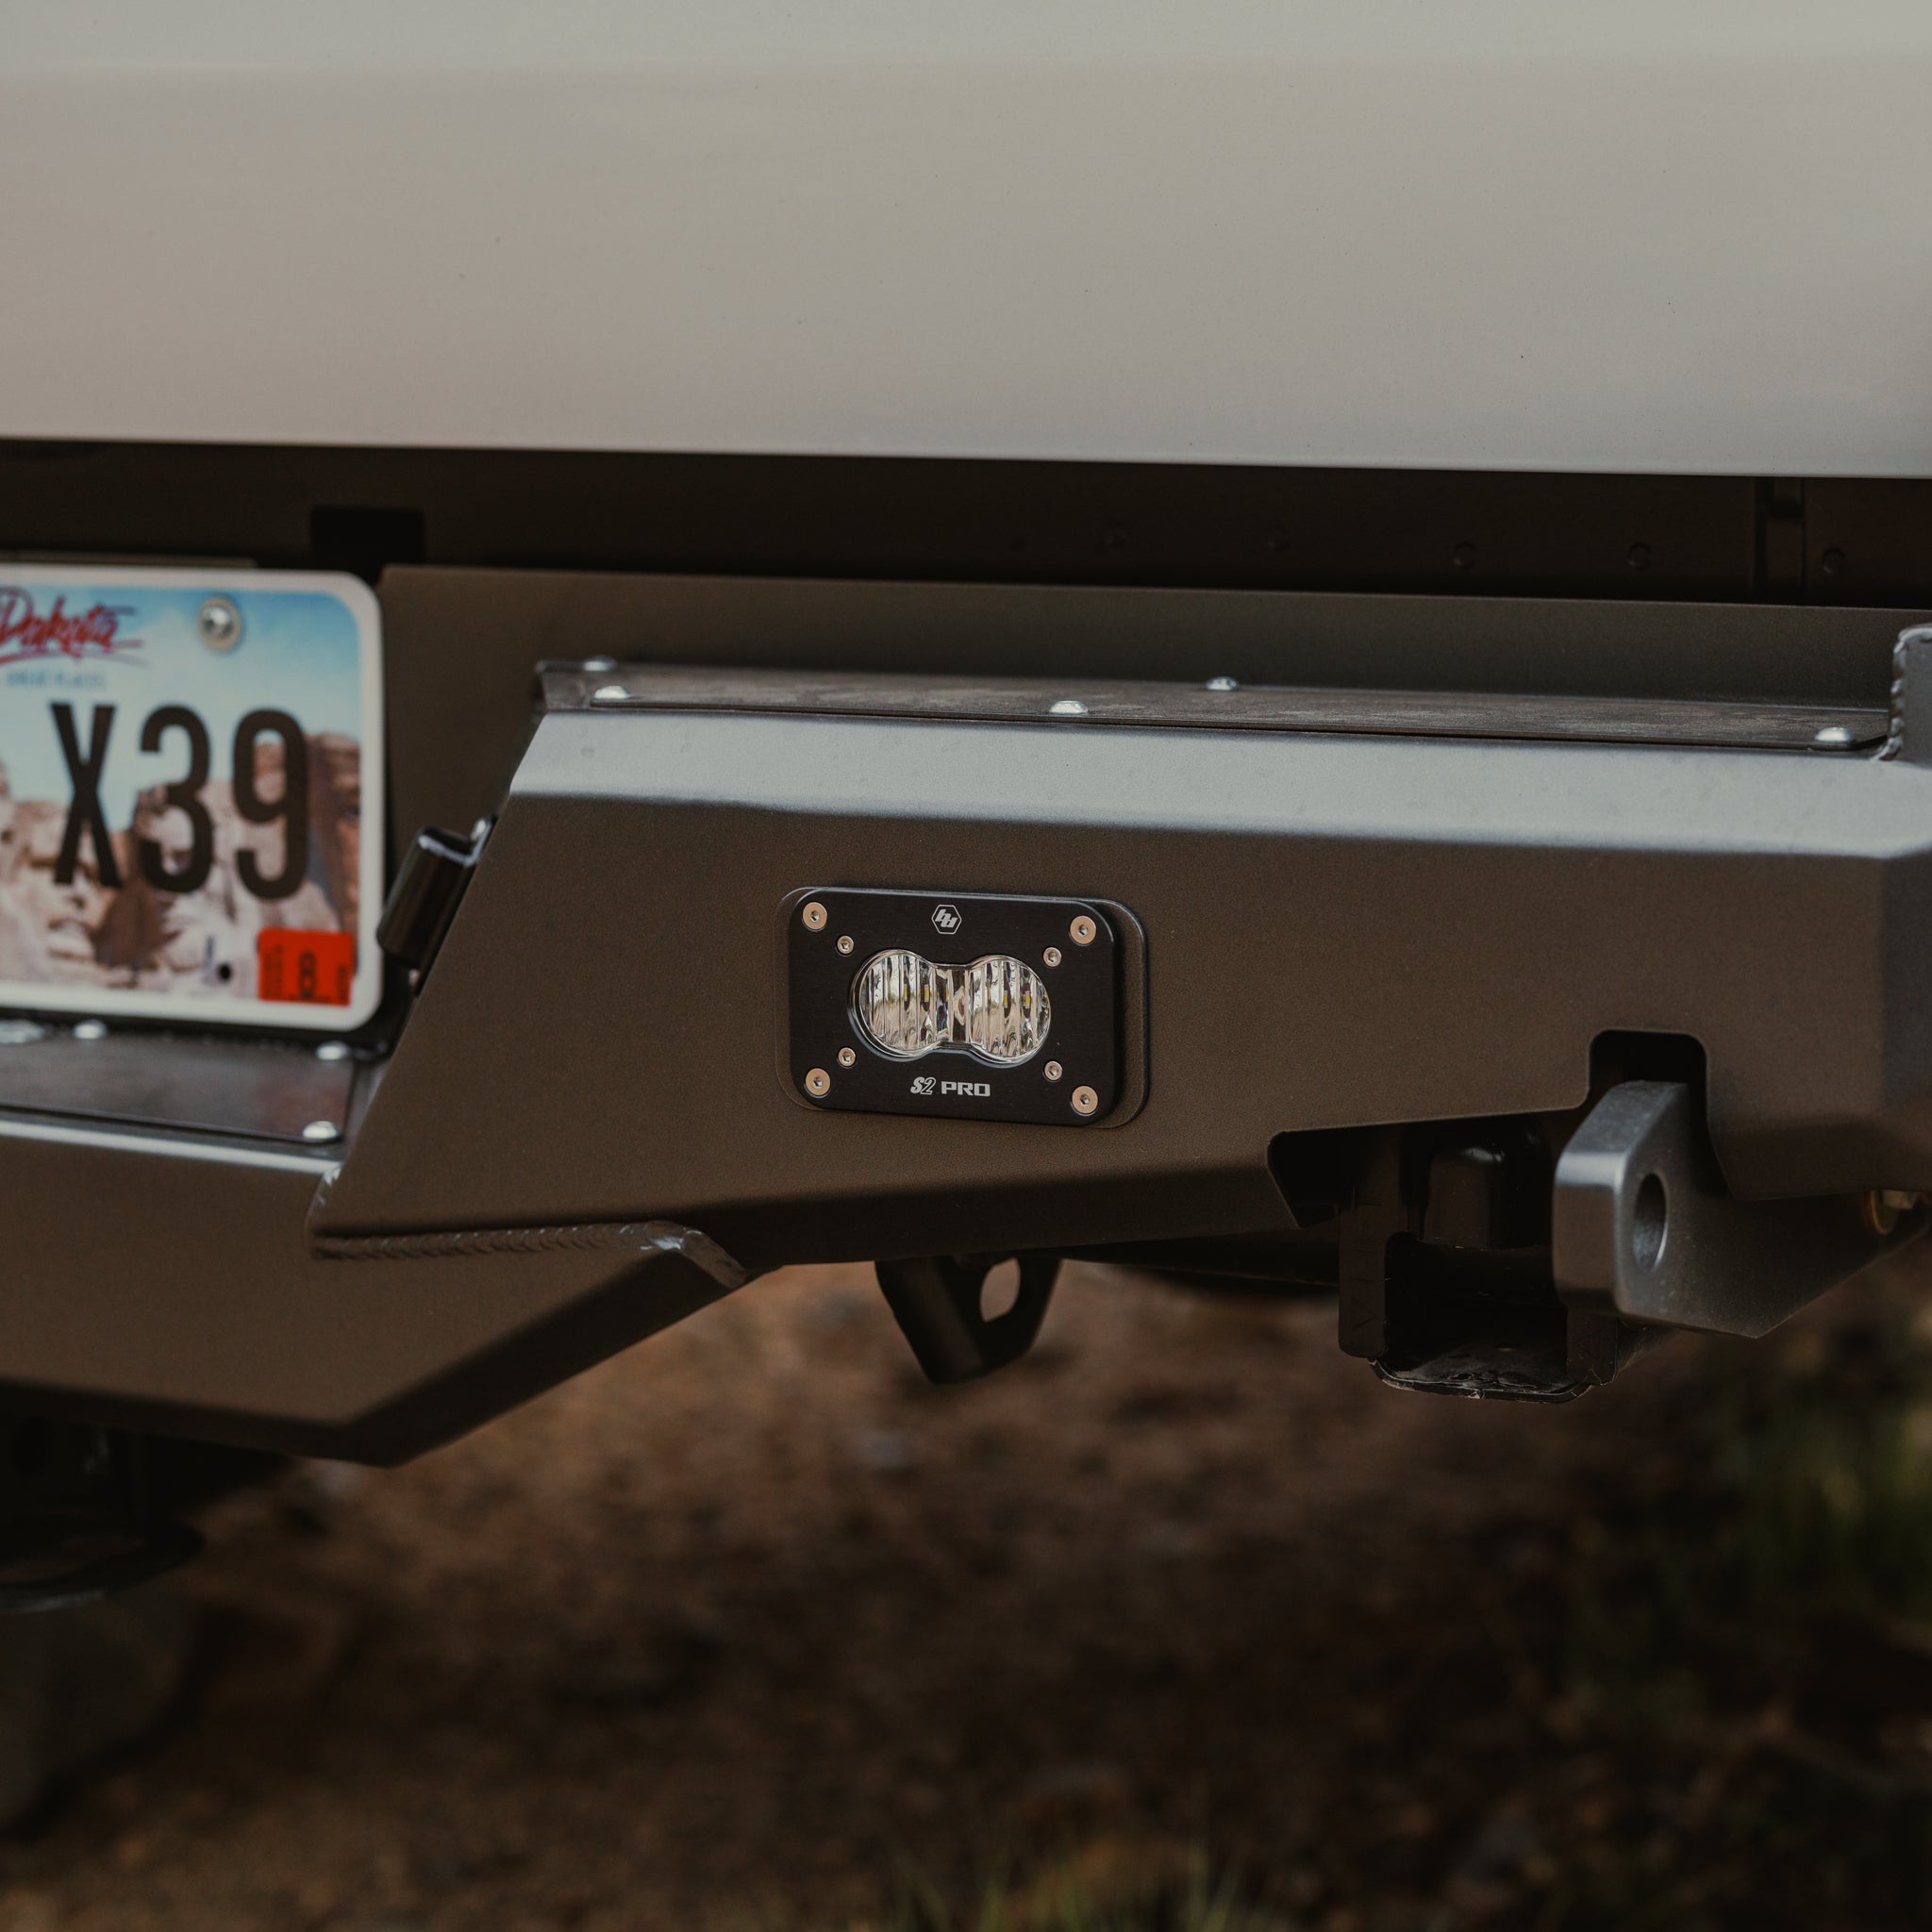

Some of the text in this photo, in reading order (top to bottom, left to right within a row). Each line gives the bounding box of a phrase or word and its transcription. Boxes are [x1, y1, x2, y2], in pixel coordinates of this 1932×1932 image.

[50, 703, 311, 900] X39
[910, 1076, 991, 1097] S2 PRO
